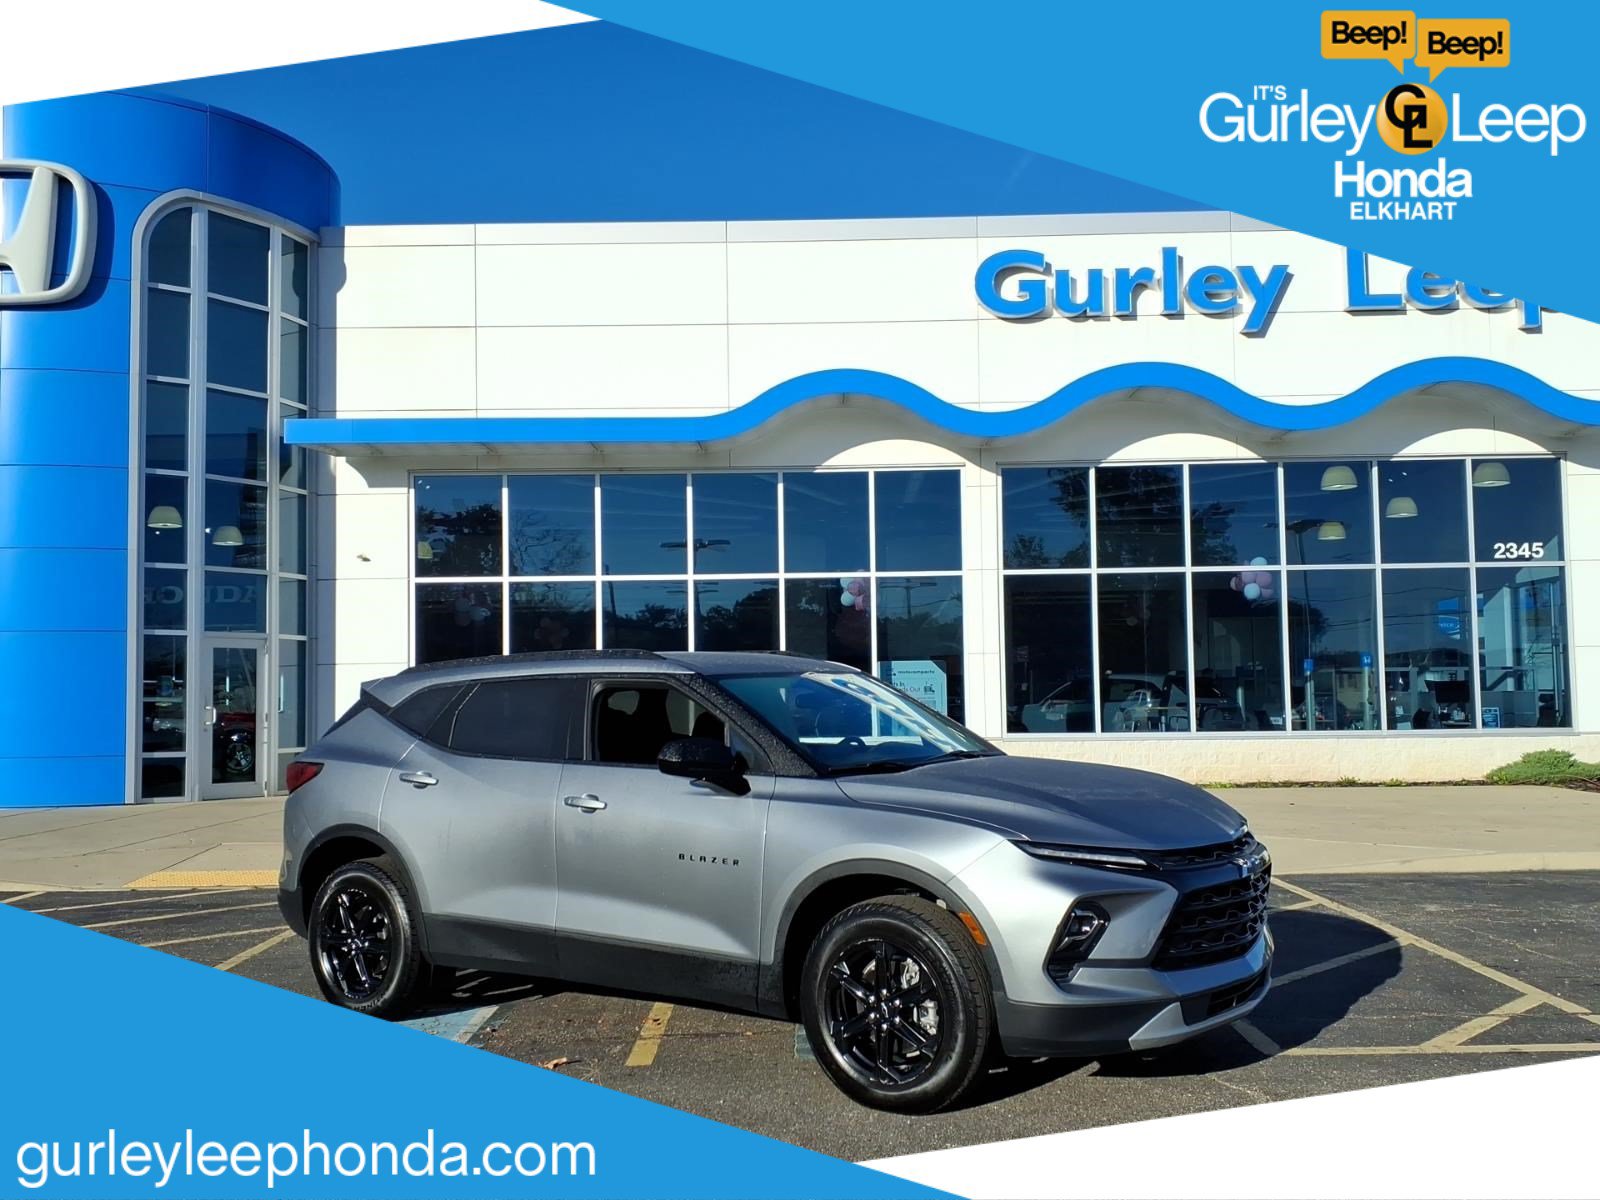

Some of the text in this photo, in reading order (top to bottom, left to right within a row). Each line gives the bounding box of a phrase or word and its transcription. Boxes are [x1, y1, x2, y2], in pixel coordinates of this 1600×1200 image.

[975, 247, 1291, 334] Gurley
[1493, 542, 1545, 559] 2345
[678, 853, 740, 867] BLAZER
